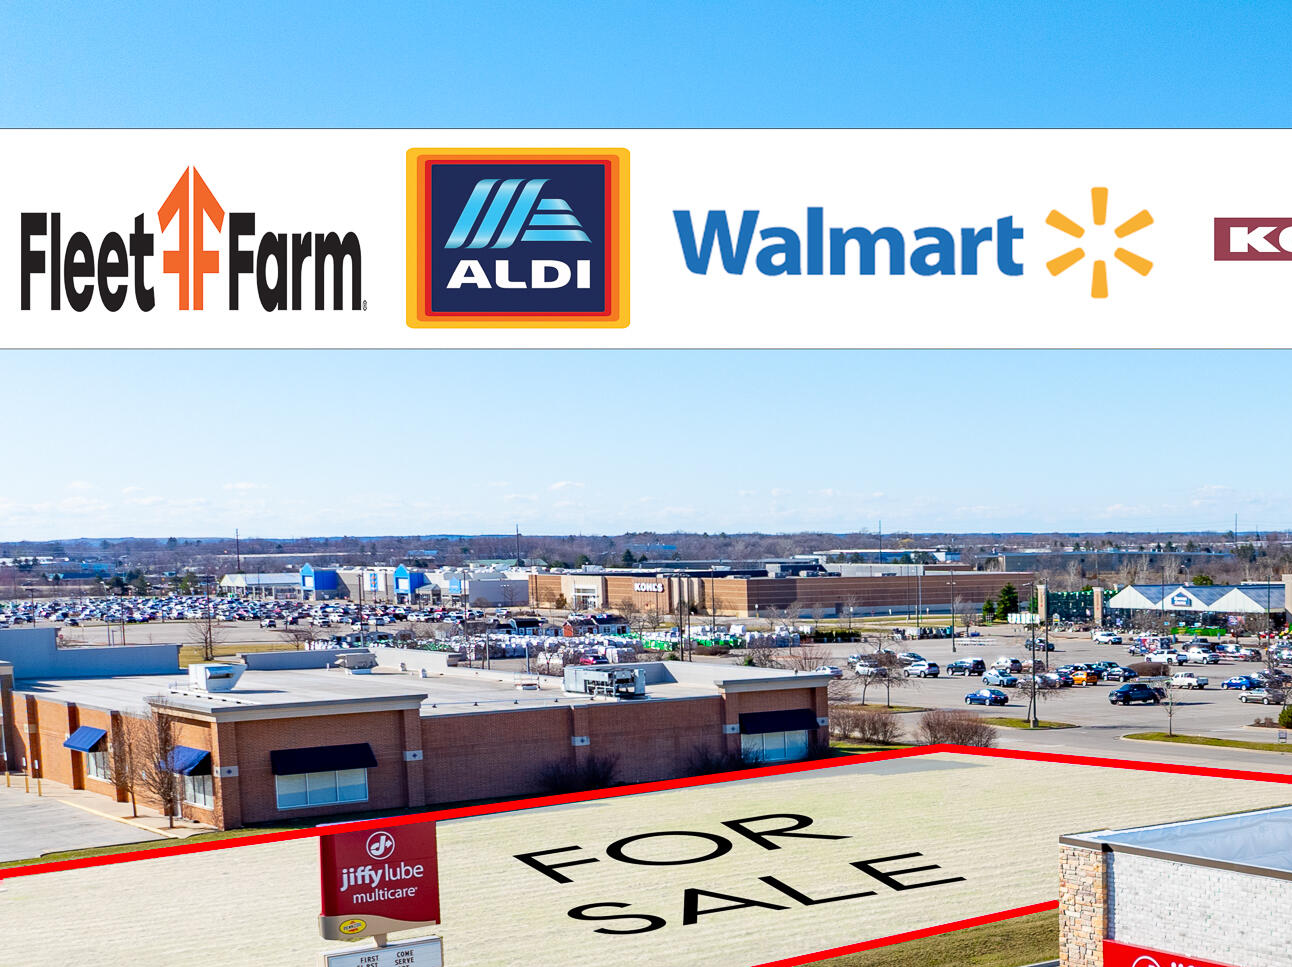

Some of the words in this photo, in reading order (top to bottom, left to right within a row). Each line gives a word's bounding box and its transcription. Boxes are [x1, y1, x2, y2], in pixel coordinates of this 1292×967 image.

[352, 887, 416, 904] multicare
[360, 955, 379, 964] FIRST
[396, 950, 414, 958] COME
[395, 957, 415, 966] SERVE
